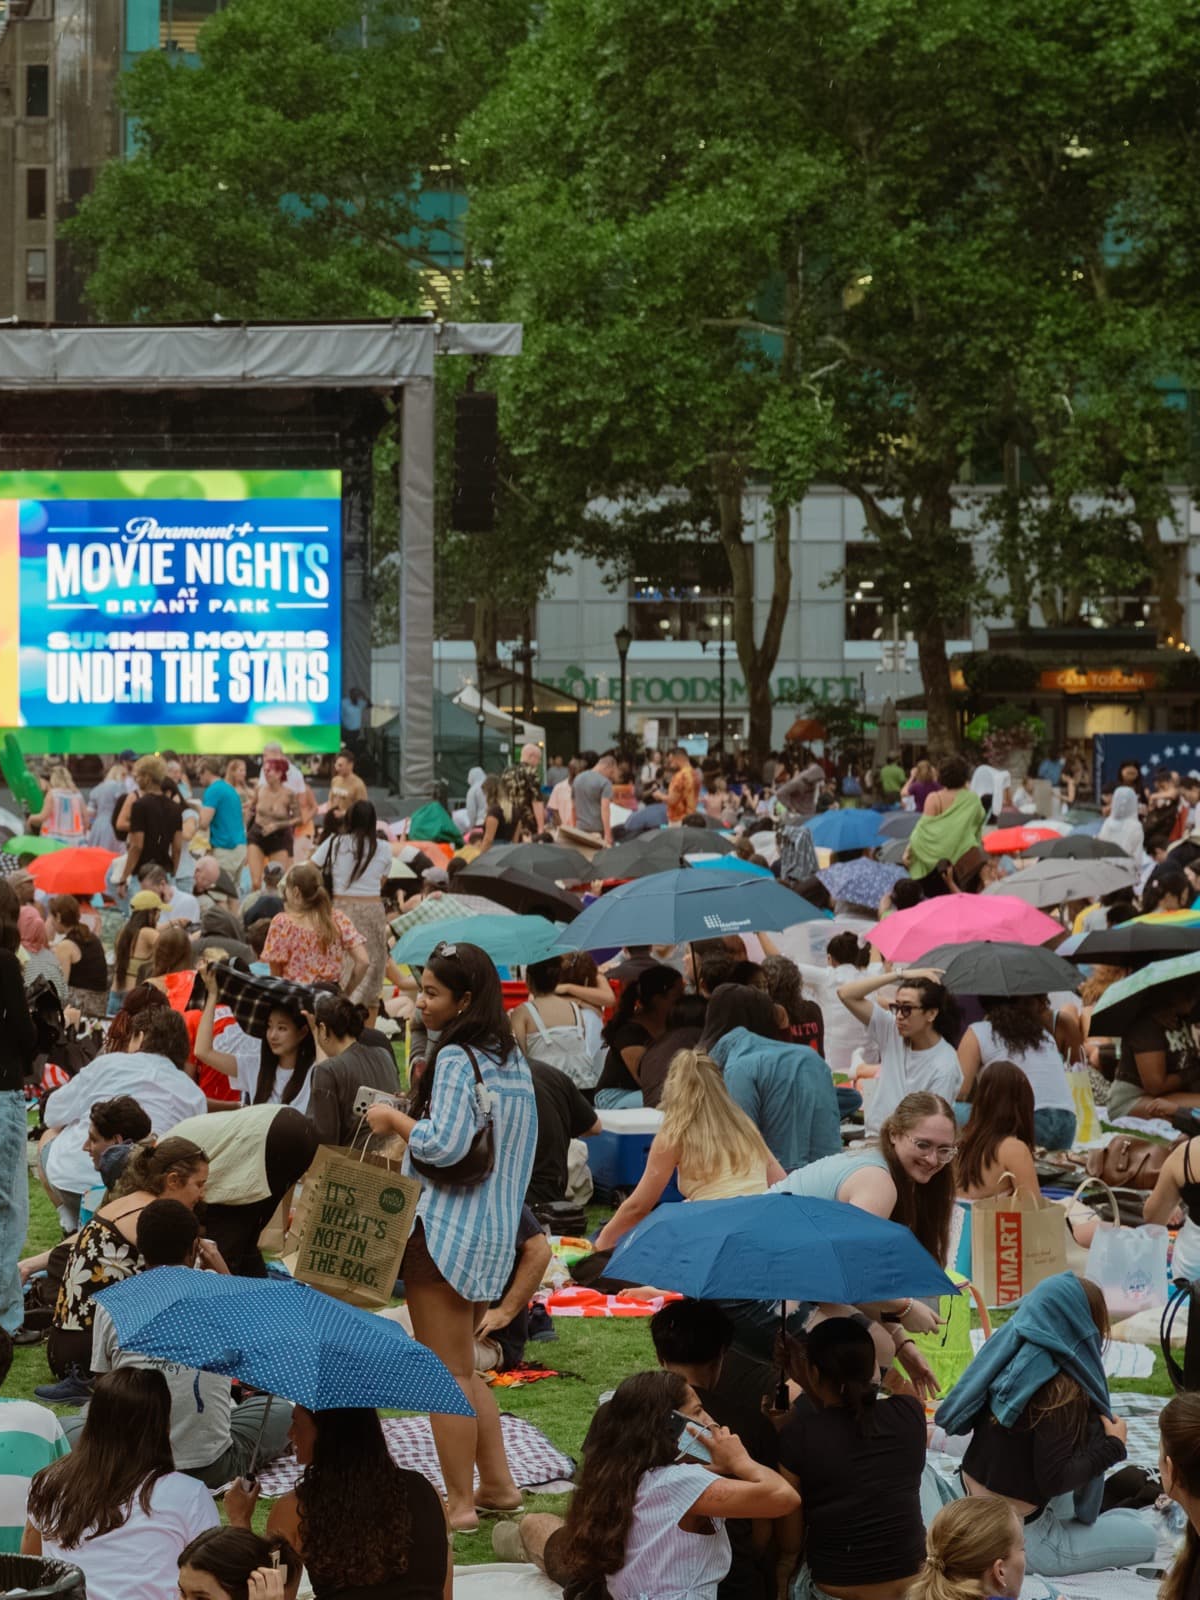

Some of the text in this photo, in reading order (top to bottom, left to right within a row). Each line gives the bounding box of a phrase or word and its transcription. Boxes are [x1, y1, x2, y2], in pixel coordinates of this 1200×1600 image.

[121, 516, 255, 544] Paramount+
[46, 541, 330, 601] MOVIE NIGHTS
[105, 599, 270, 614] BRYANT PARK
[176, 587, 199, 599] AT
[47, 630, 330, 651] SUMMER MOVIES
[46, 650, 330, 704] UNDER THE STARS
[629, 676, 721, 704] FOODS
[729, 676, 858, 704] MRKET
[324, 1180, 358, 1207] IT'S
[320, 1204, 388, 1240] WHAT'S
[311, 1226, 369, 1260] NOT IN
[999, 1217, 1019, 1282] MART
[308, 1250, 380, 1288] THE BAG.
